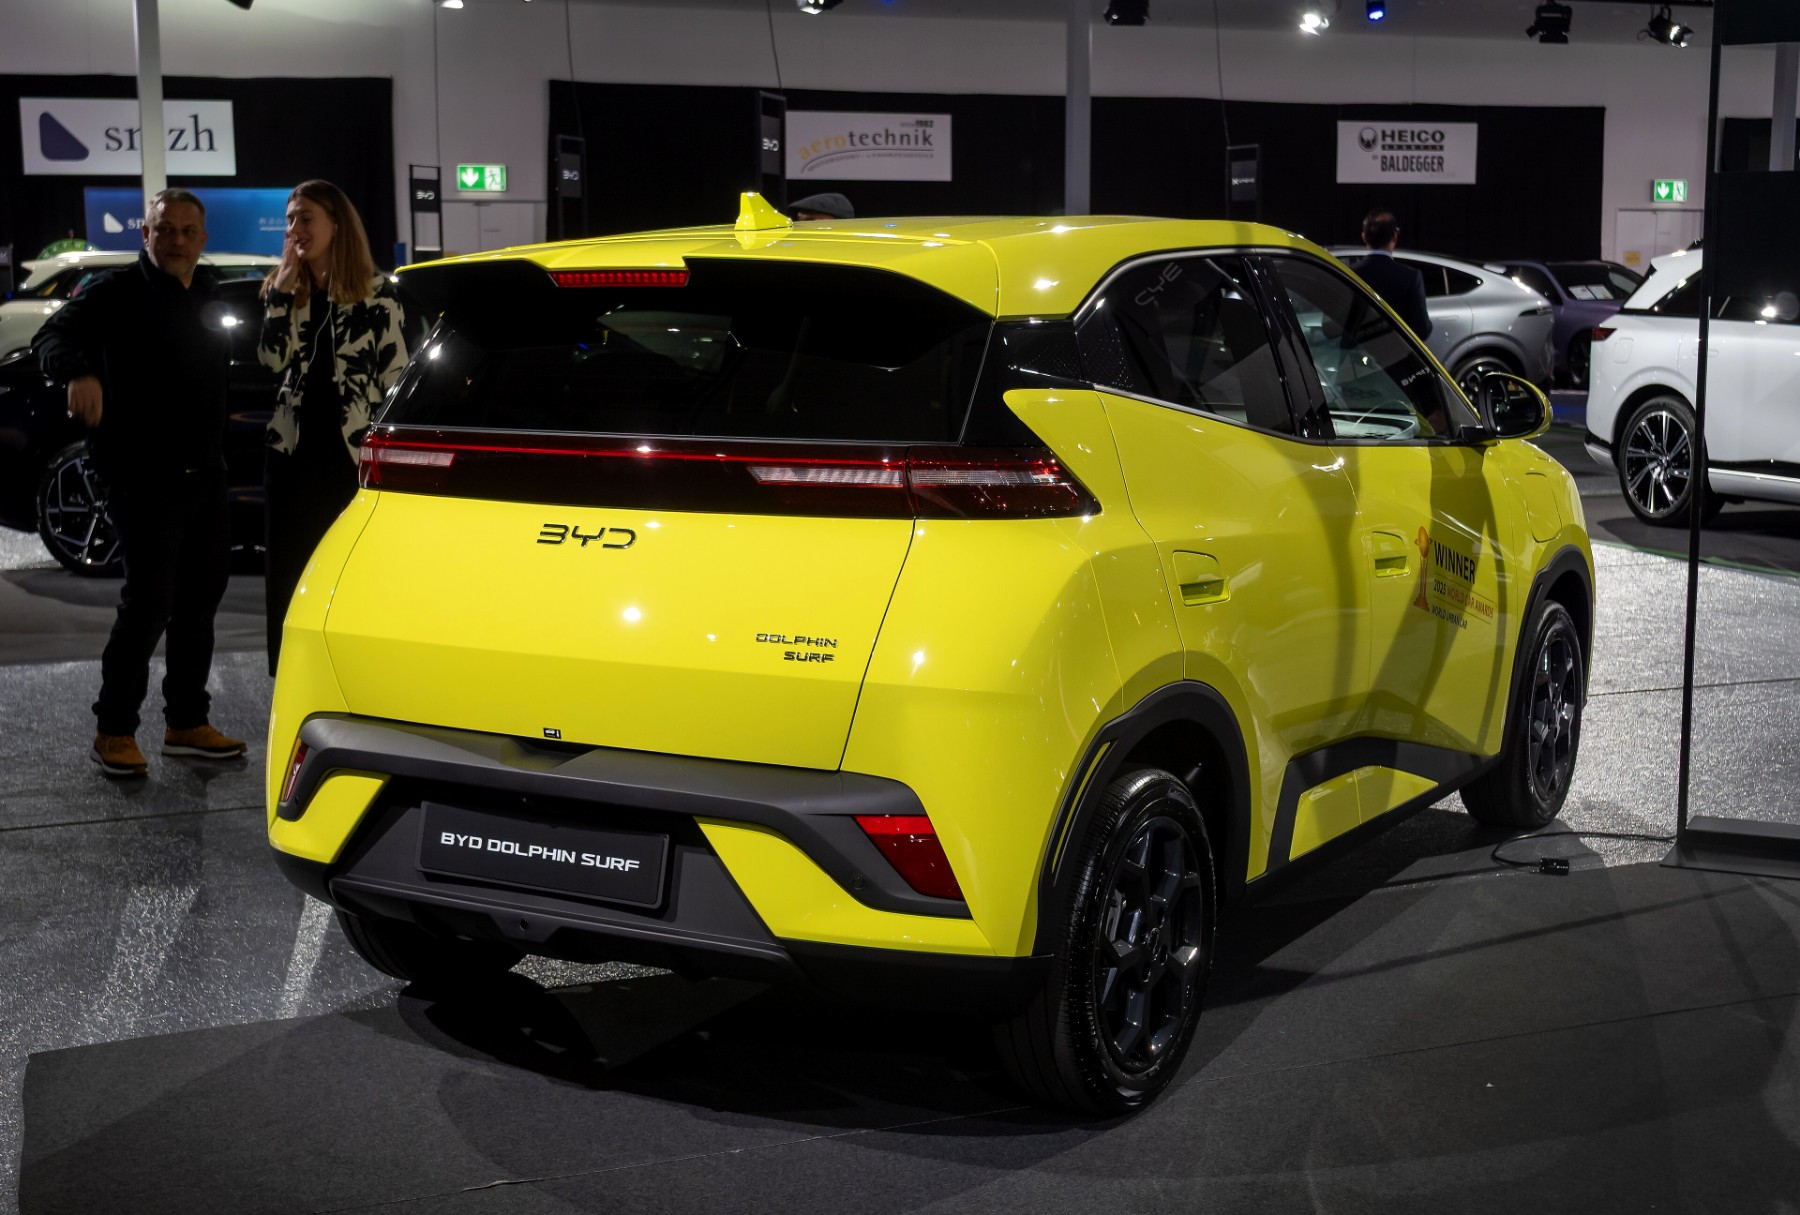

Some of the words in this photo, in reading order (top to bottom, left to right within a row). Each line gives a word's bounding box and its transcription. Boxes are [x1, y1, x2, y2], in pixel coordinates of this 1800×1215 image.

[799, 128, 933, 161] aerotechnik
[1381, 129, 1445, 143] HEICO
[1381, 155, 1444, 172] BALDEGGER
[536, 523, 637, 550] BYD
[1434, 540, 1476, 585] WINNER
[1433, 578, 1447, 596] 2025
[1447, 585, 1464, 604] WORLD
[1464, 593, 1475, 609] CAR
[1475, 600, 1494, 619] AWARDS
[755, 633, 837, 649] DOLPHIN
[783, 650, 835, 663] SURF
[440, 831, 482, 850] BYD
[487, 838, 576, 864] DOLPHIN
[580, 853, 640, 872] SURF
